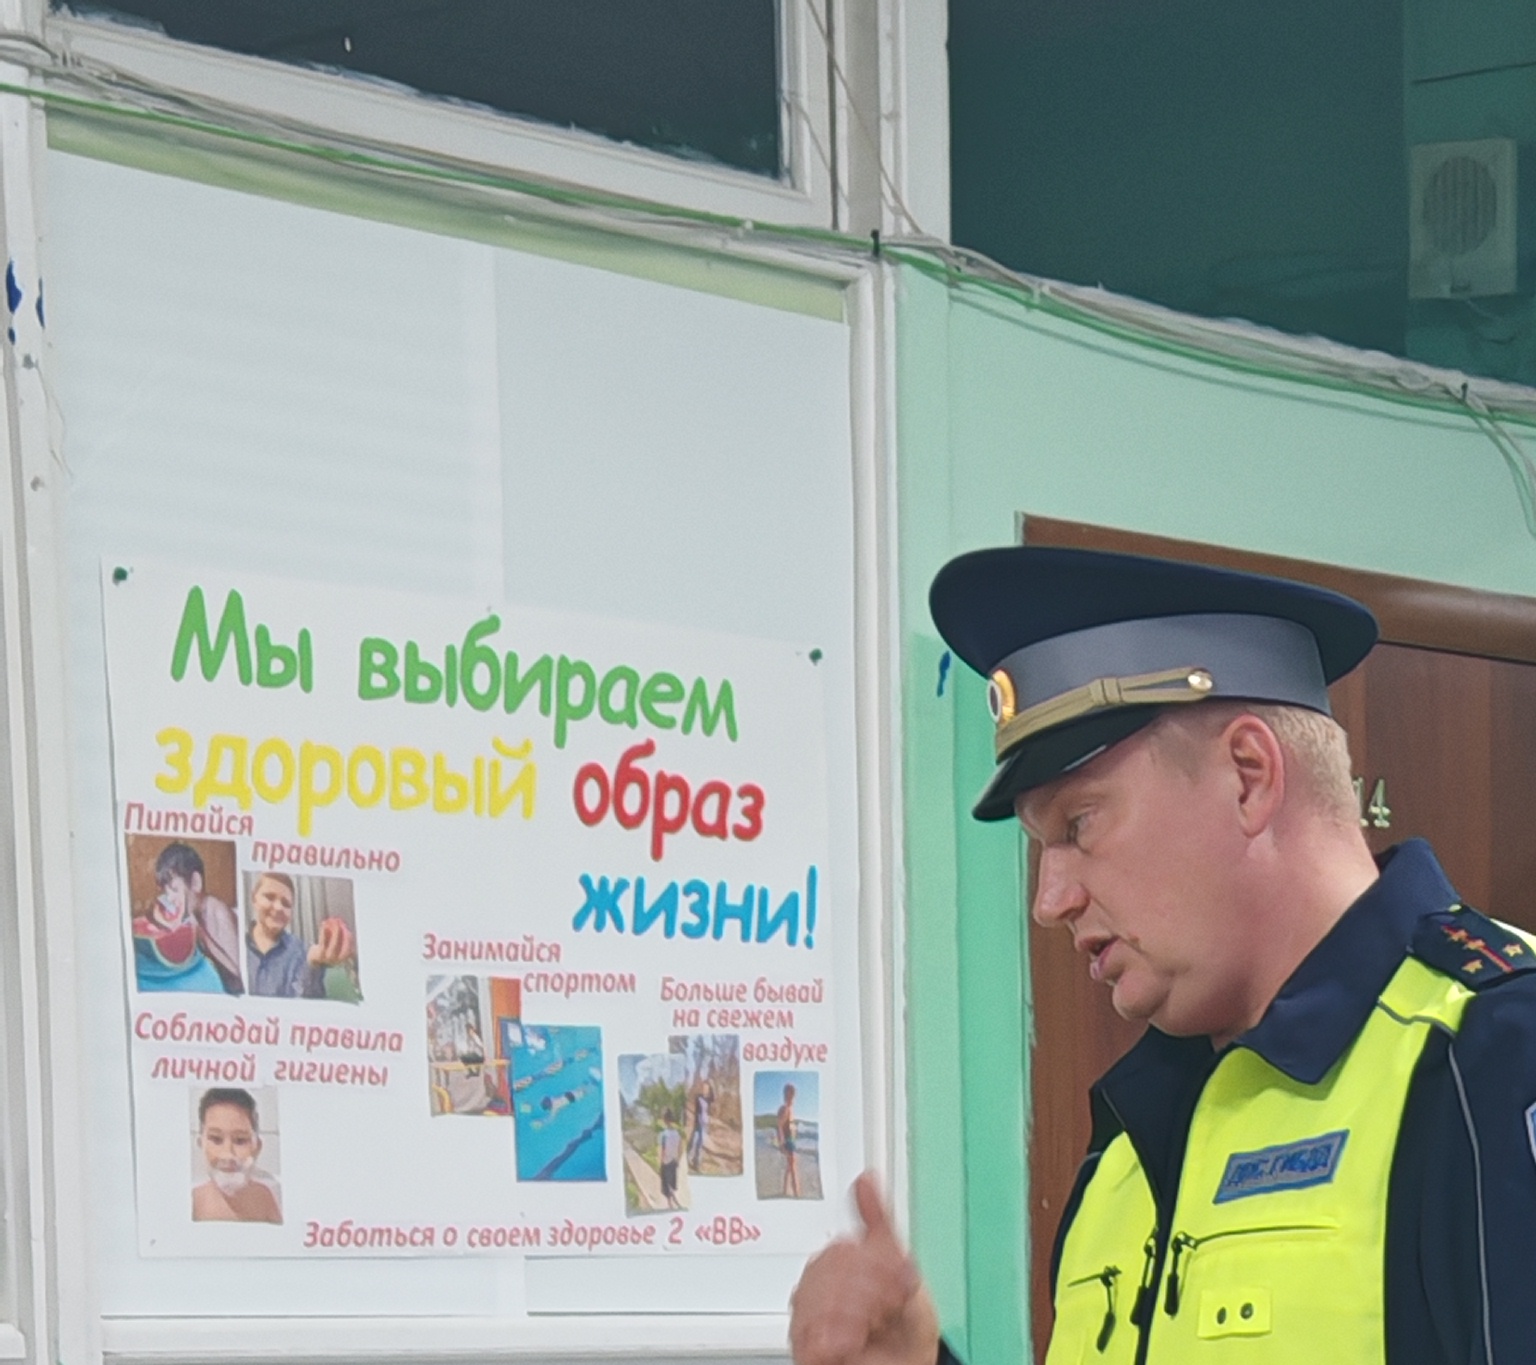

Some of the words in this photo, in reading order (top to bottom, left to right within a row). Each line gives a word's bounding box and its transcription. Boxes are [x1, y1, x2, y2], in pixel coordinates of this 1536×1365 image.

[172, 585, 313, 692] Мы
[358, 613, 739, 748] выбираем
[155, 727, 537, 837] здоровый
[574, 739, 766, 860] образ
[125, 803, 254, 837] Питайся
[252, 841, 400, 873] правильно
[573, 864, 818, 949] жизни!
[422, 934, 562, 963] Занимайся
[522, 971, 635, 998] спортом
[660, 977, 749, 1002] Больше
[753, 978, 823, 1003] бывай
[135, 1013, 279, 1046] Соблюдай
[289, 1024, 404, 1053] правила
[673, 1008, 701, 1027] на
[706, 1008, 795, 1030] свежем
[743, 1040, 828, 1066] воздухе
[151, 1055, 256, 1082] личной
[275, 1061, 389, 1086] гигиены
[303, 1221, 436, 1248] Заботься
[443, 1229, 457, 1246] о
[467, 1229, 541, 1247] своем
[548, 1222, 656, 1249] здоровье
[668, 1220, 683, 1244] 2
